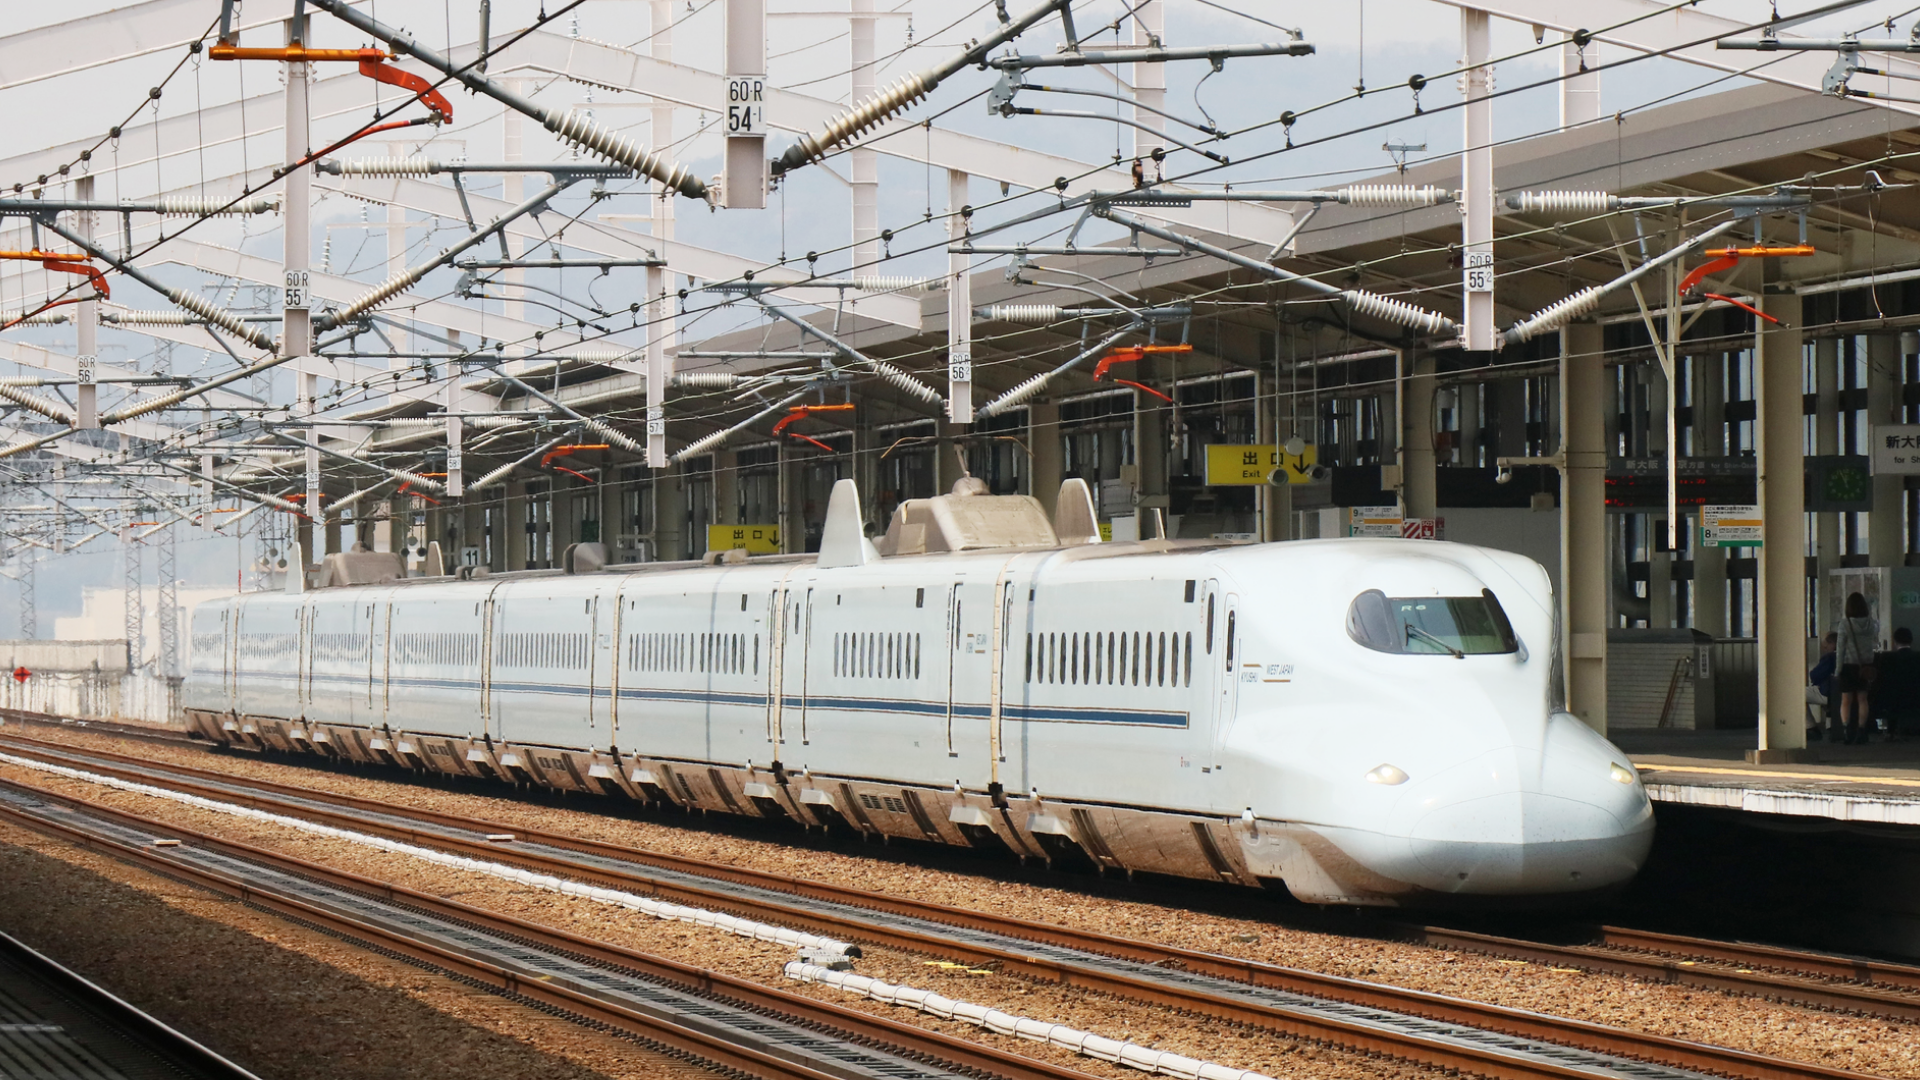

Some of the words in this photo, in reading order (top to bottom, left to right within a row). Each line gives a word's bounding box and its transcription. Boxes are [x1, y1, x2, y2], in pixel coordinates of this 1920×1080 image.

[1469, 271, 1492, 288] 55-2
[1886, 435, 1920, 449] 新大
[1242, 470, 1260, 478] Exit
[1353, 509, 1359, 517] 9
[1353, 526, 1359, 535] 7
[1704, 529, 1711, 538] 8
[465, 550, 478, 566] 11
[1279, 664, 1295, 675] JAPAN
